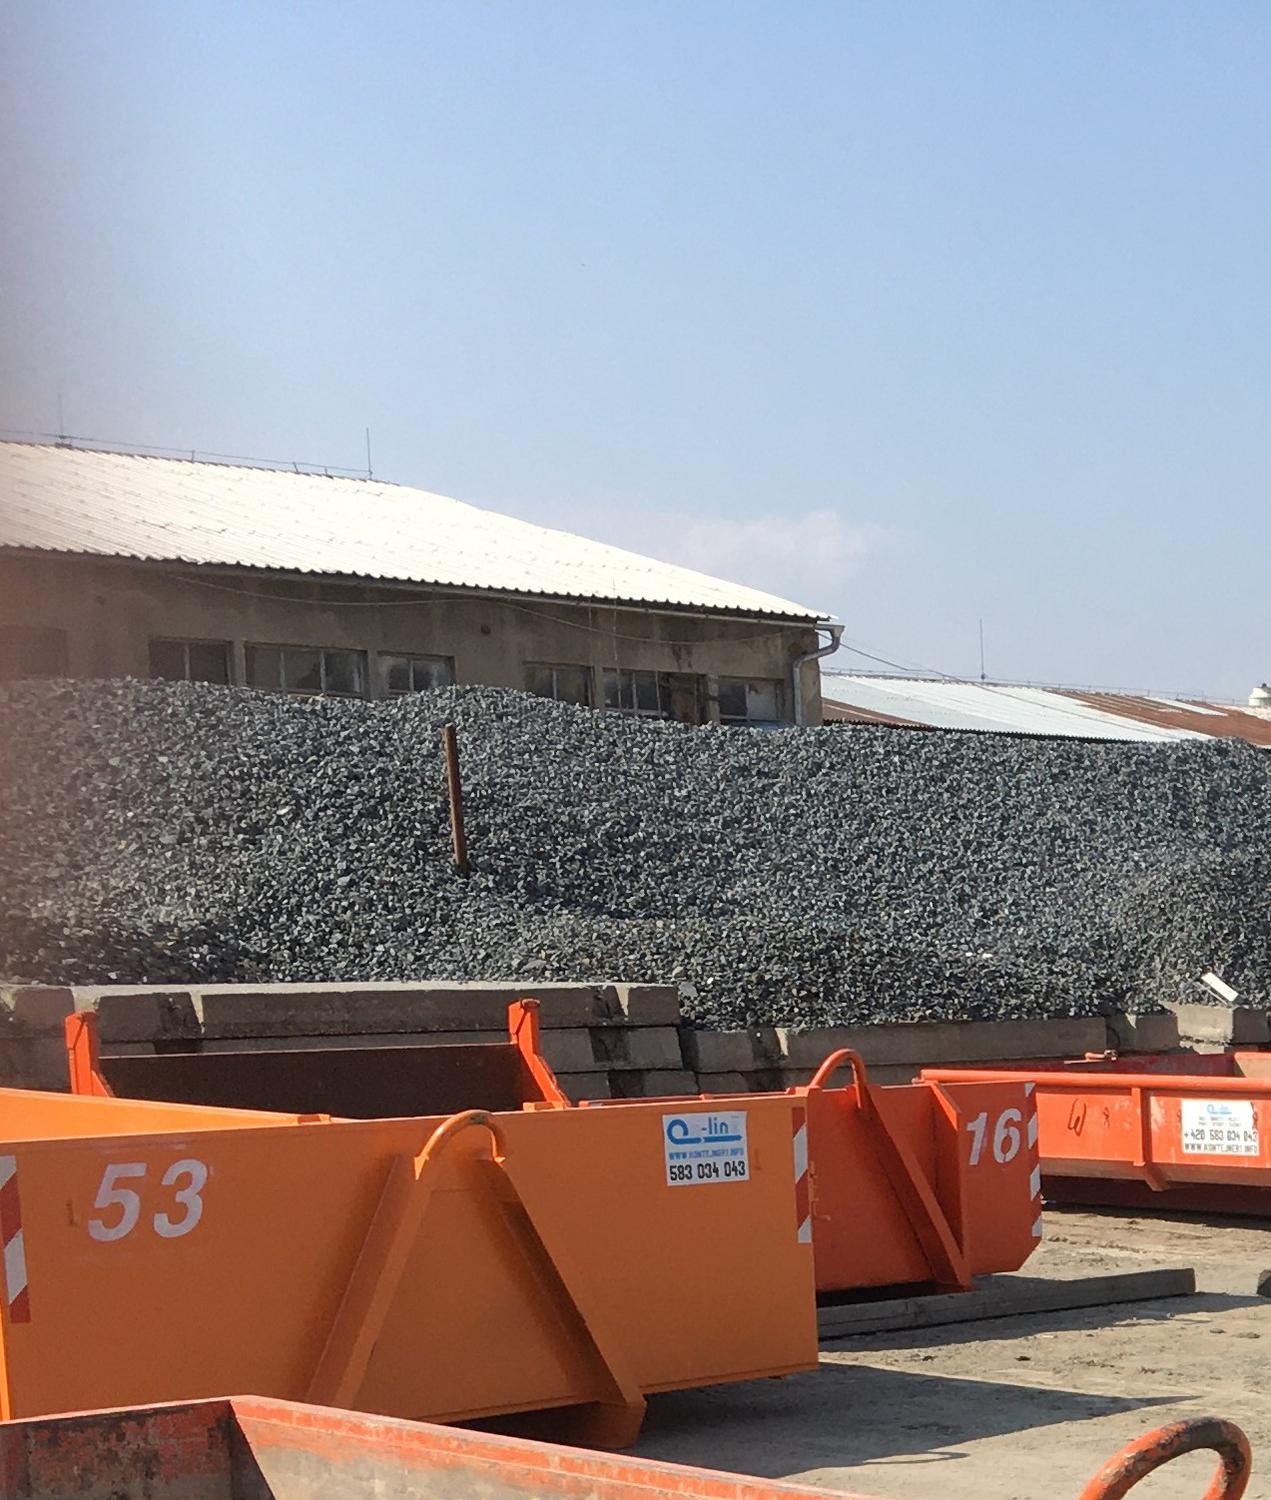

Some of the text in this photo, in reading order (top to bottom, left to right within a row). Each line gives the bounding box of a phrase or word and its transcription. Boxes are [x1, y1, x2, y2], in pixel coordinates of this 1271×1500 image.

[966, 1107, 1022, 1166] 16
[87, 1158, 208, 1242] 53
[669, 1160, 746, 1181] 583 034 043
